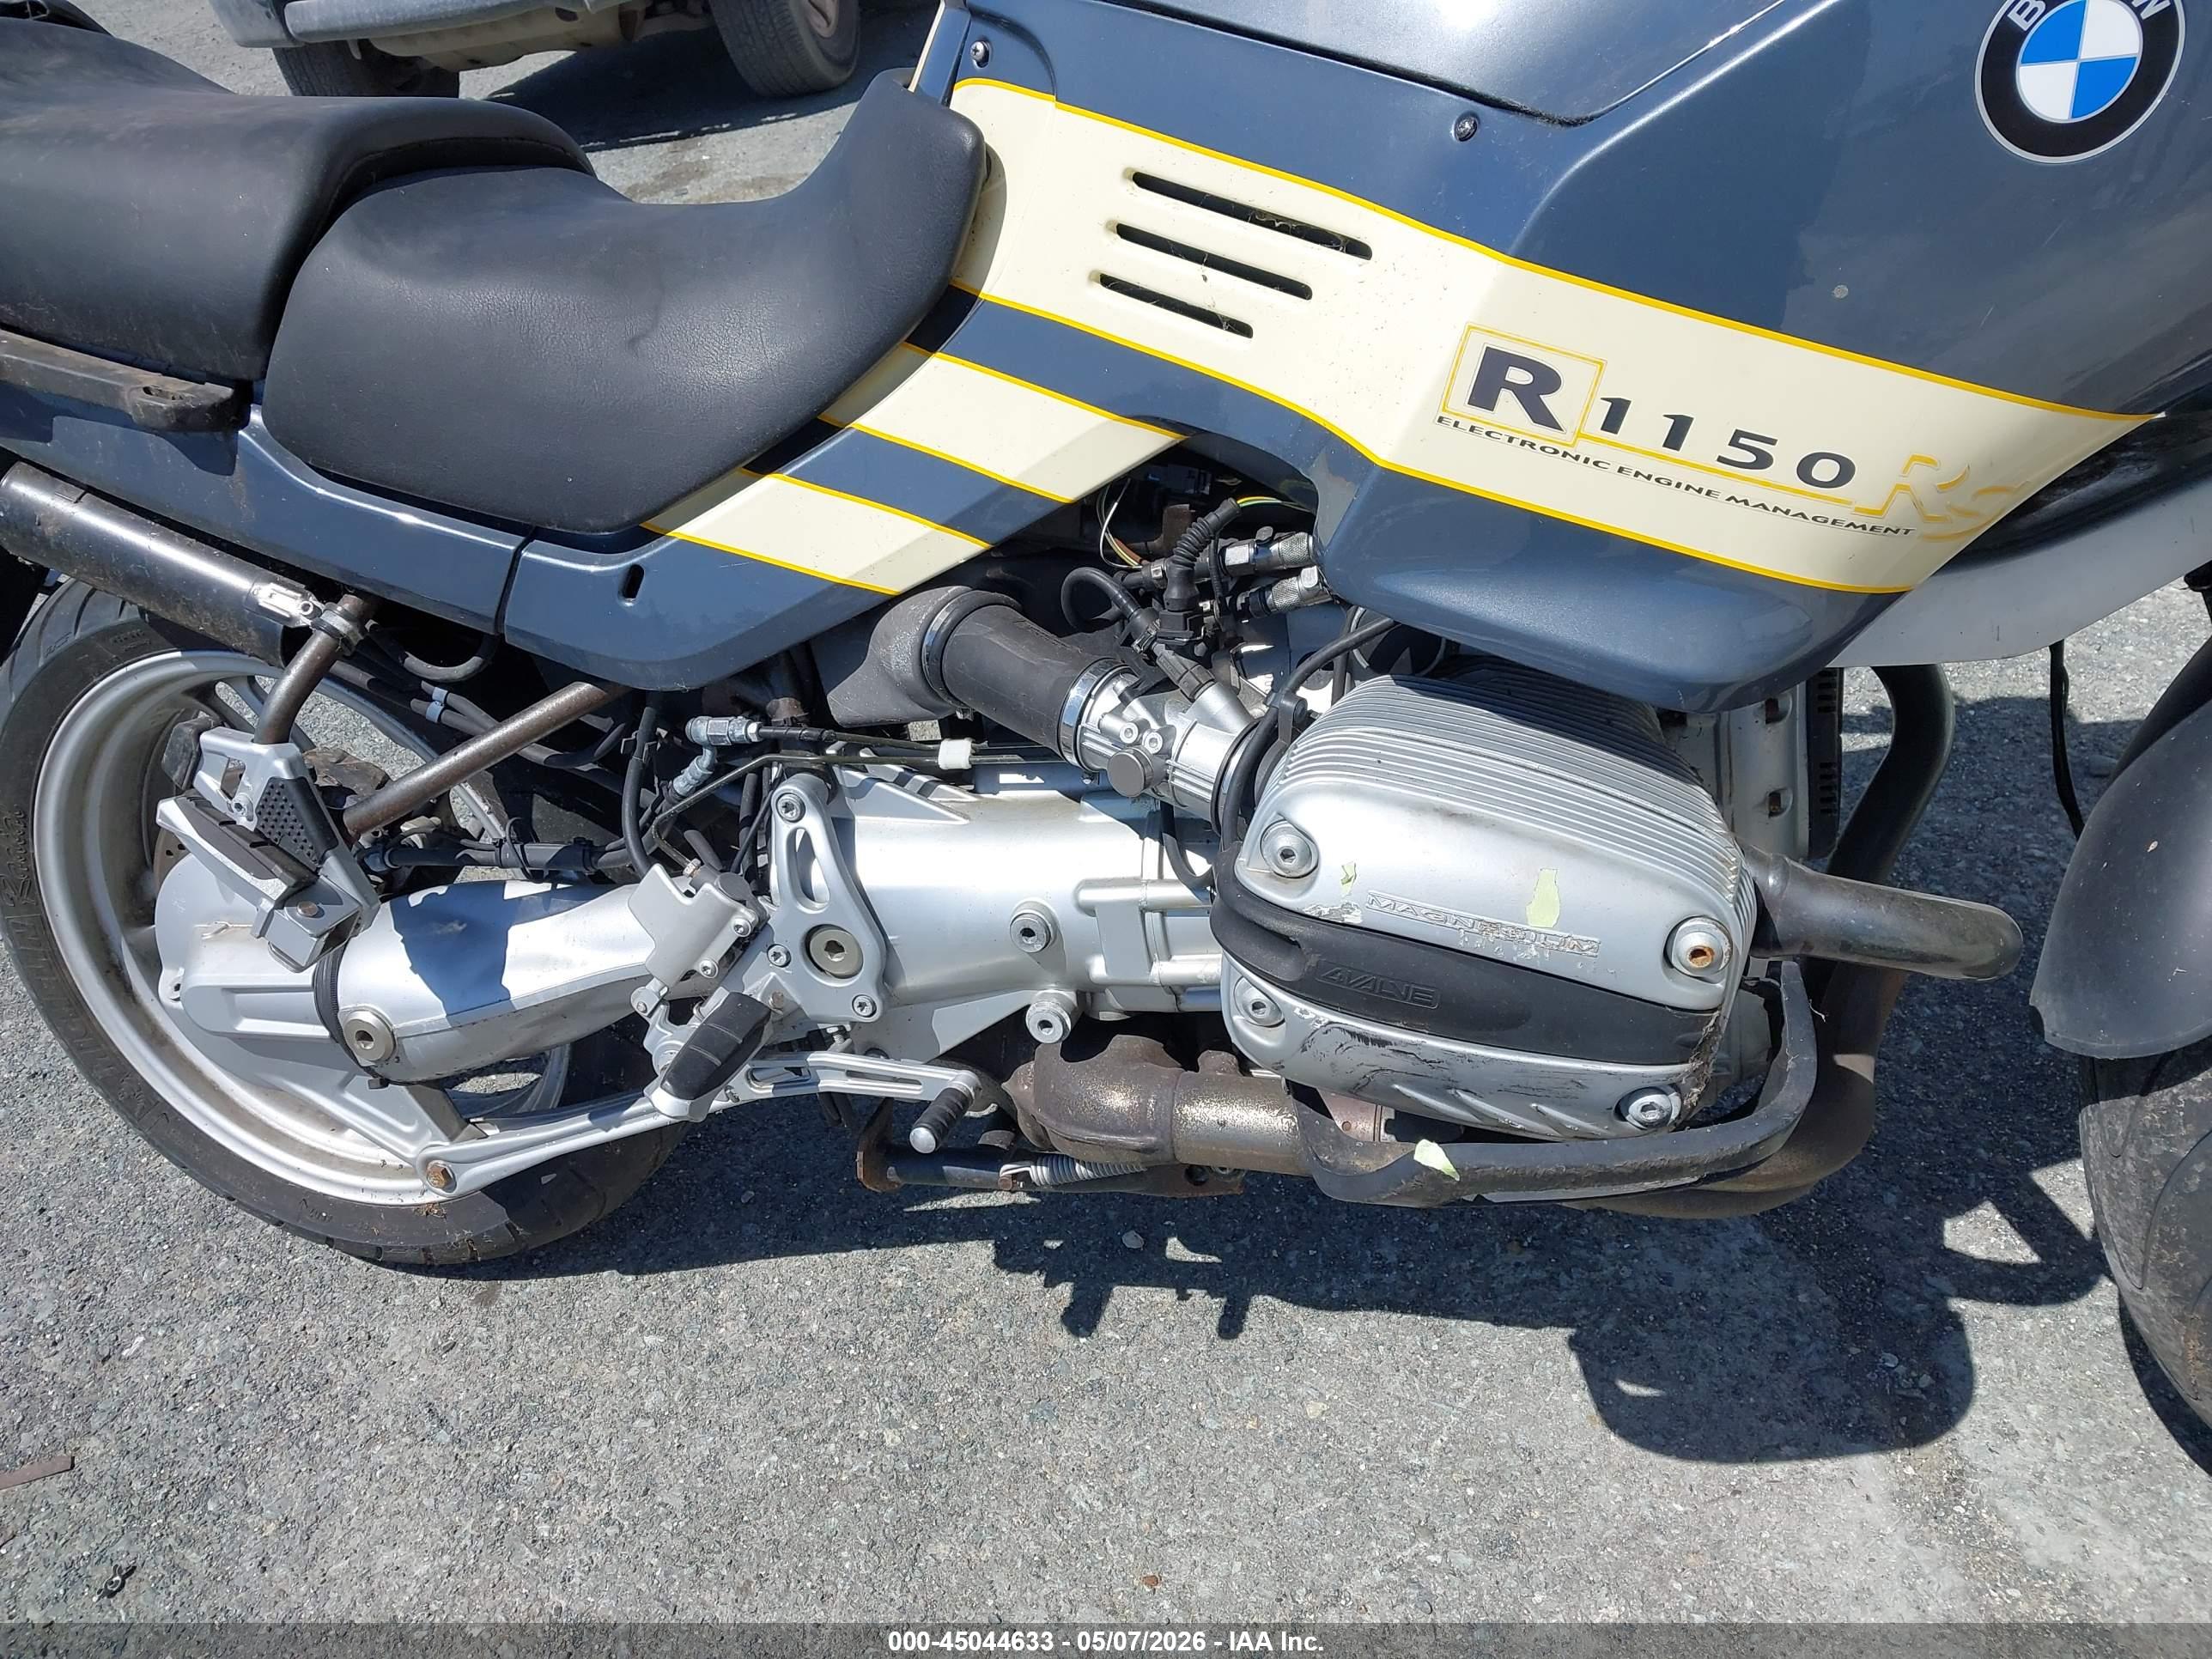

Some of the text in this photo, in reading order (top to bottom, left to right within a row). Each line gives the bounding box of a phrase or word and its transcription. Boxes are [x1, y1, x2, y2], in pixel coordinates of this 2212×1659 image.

[1436, 416, 1916, 536] ELECTRONIC ENGINE MANAGEMENT
[1468, 345, 1565, 434] R
[1599, 397, 1856, 489] 1150
